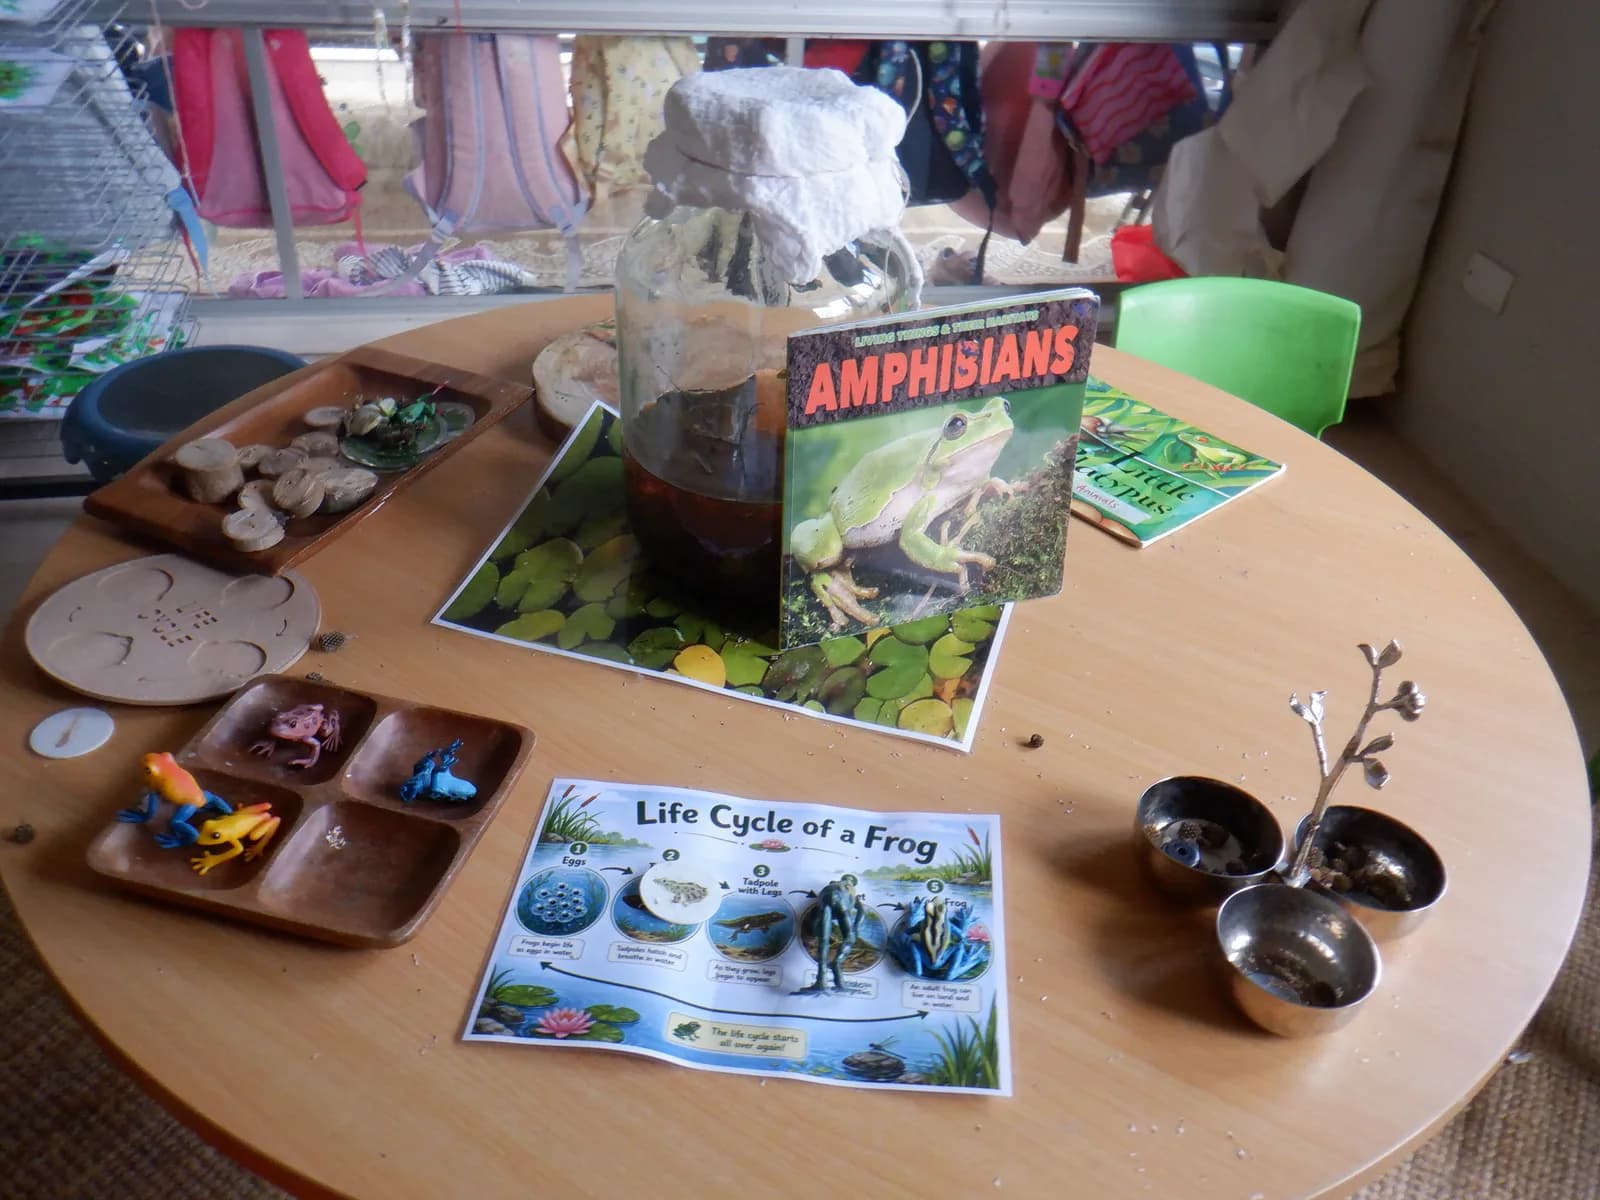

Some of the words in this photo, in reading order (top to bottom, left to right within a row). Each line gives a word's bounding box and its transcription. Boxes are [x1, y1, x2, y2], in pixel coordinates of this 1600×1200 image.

[854, 331, 895, 348] LIVING
[896, 325, 940, 341] THINGS
[940, 325, 951, 335] &
[951, 319, 985, 333] THEIR
[985, 310, 1040, 328] HABITATS
[804, 325, 1079, 415] AMPHIBIANS
[1075, 447, 1173, 515] latypus
[1111, 445, 1195, 503] Little
[1075, 484, 1120, 510] Animals
[636, 800, 699, 825] Life
[709, 804, 793, 837] Cycle
[802, 818, 835, 838] of
[840, 829, 856, 844] a
[863, 824, 938, 865] Frog
[562, 855, 587, 868] Eggs
[743, 877, 779, 889] Tadpole
[931, 880, 940, 892] 5
[738, 886, 759, 895] with
[761, 888, 783, 898] Legs
[944, 897, 967, 909] Frog
[712, 1026, 725, 1037] The
[730, 1029, 744, 1039] life
[747, 1031, 769, 1042] cycle
[772, 1033, 800, 1043] starts
[720, 1039, 733, 1047] all
